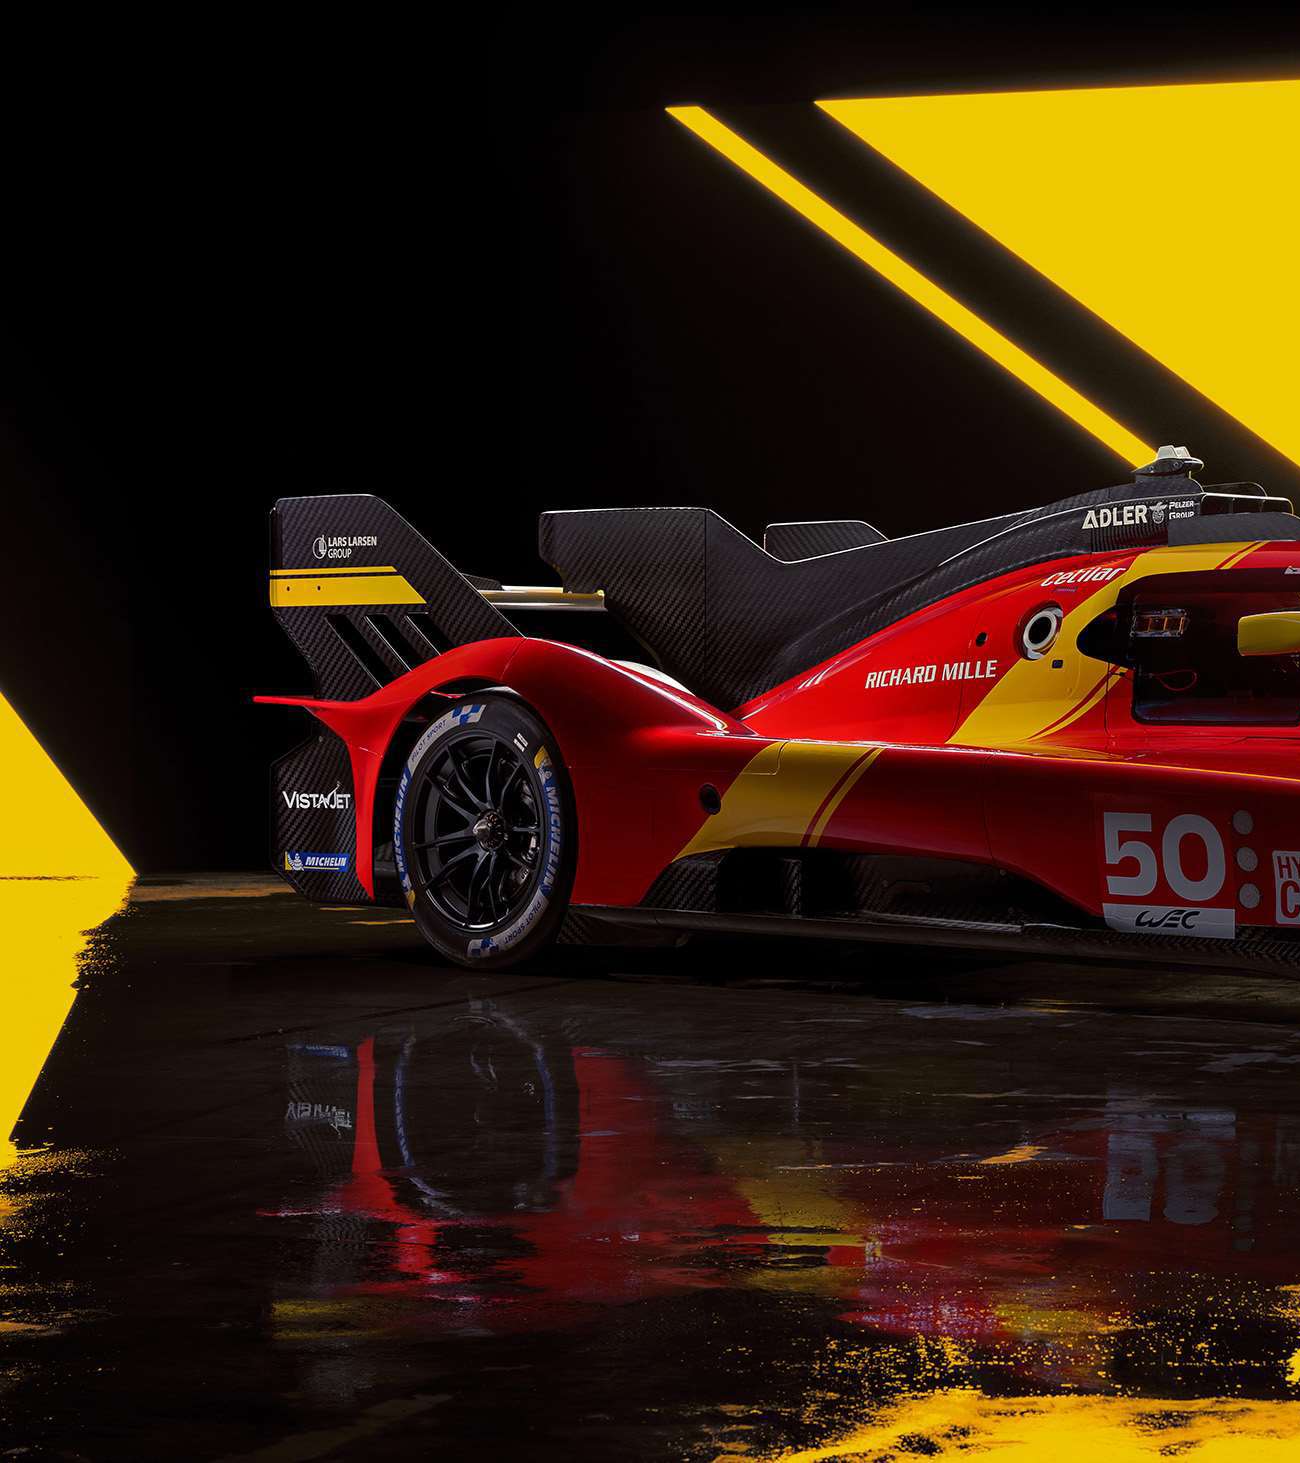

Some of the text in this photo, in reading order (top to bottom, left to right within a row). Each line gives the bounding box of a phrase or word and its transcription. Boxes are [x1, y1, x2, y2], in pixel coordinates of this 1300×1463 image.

[1169, 500, 1195, 510] PELZER
[1082, 505, 1148, 529] ADLER
[328, 536, 377, 547] LARS LARSEN
[328, 548, 352, 559] GROUP
[865, 660, 997, 688] RICHARD MILLE
[543, 786, 562, 891] MICHELIN
[305, 856, 347, 868] MICHELIN
[1103, 812, 1227, 901] 50
[1135, 909, 1201, 930] WEC
[504, 923, 529, 945] SPORT
